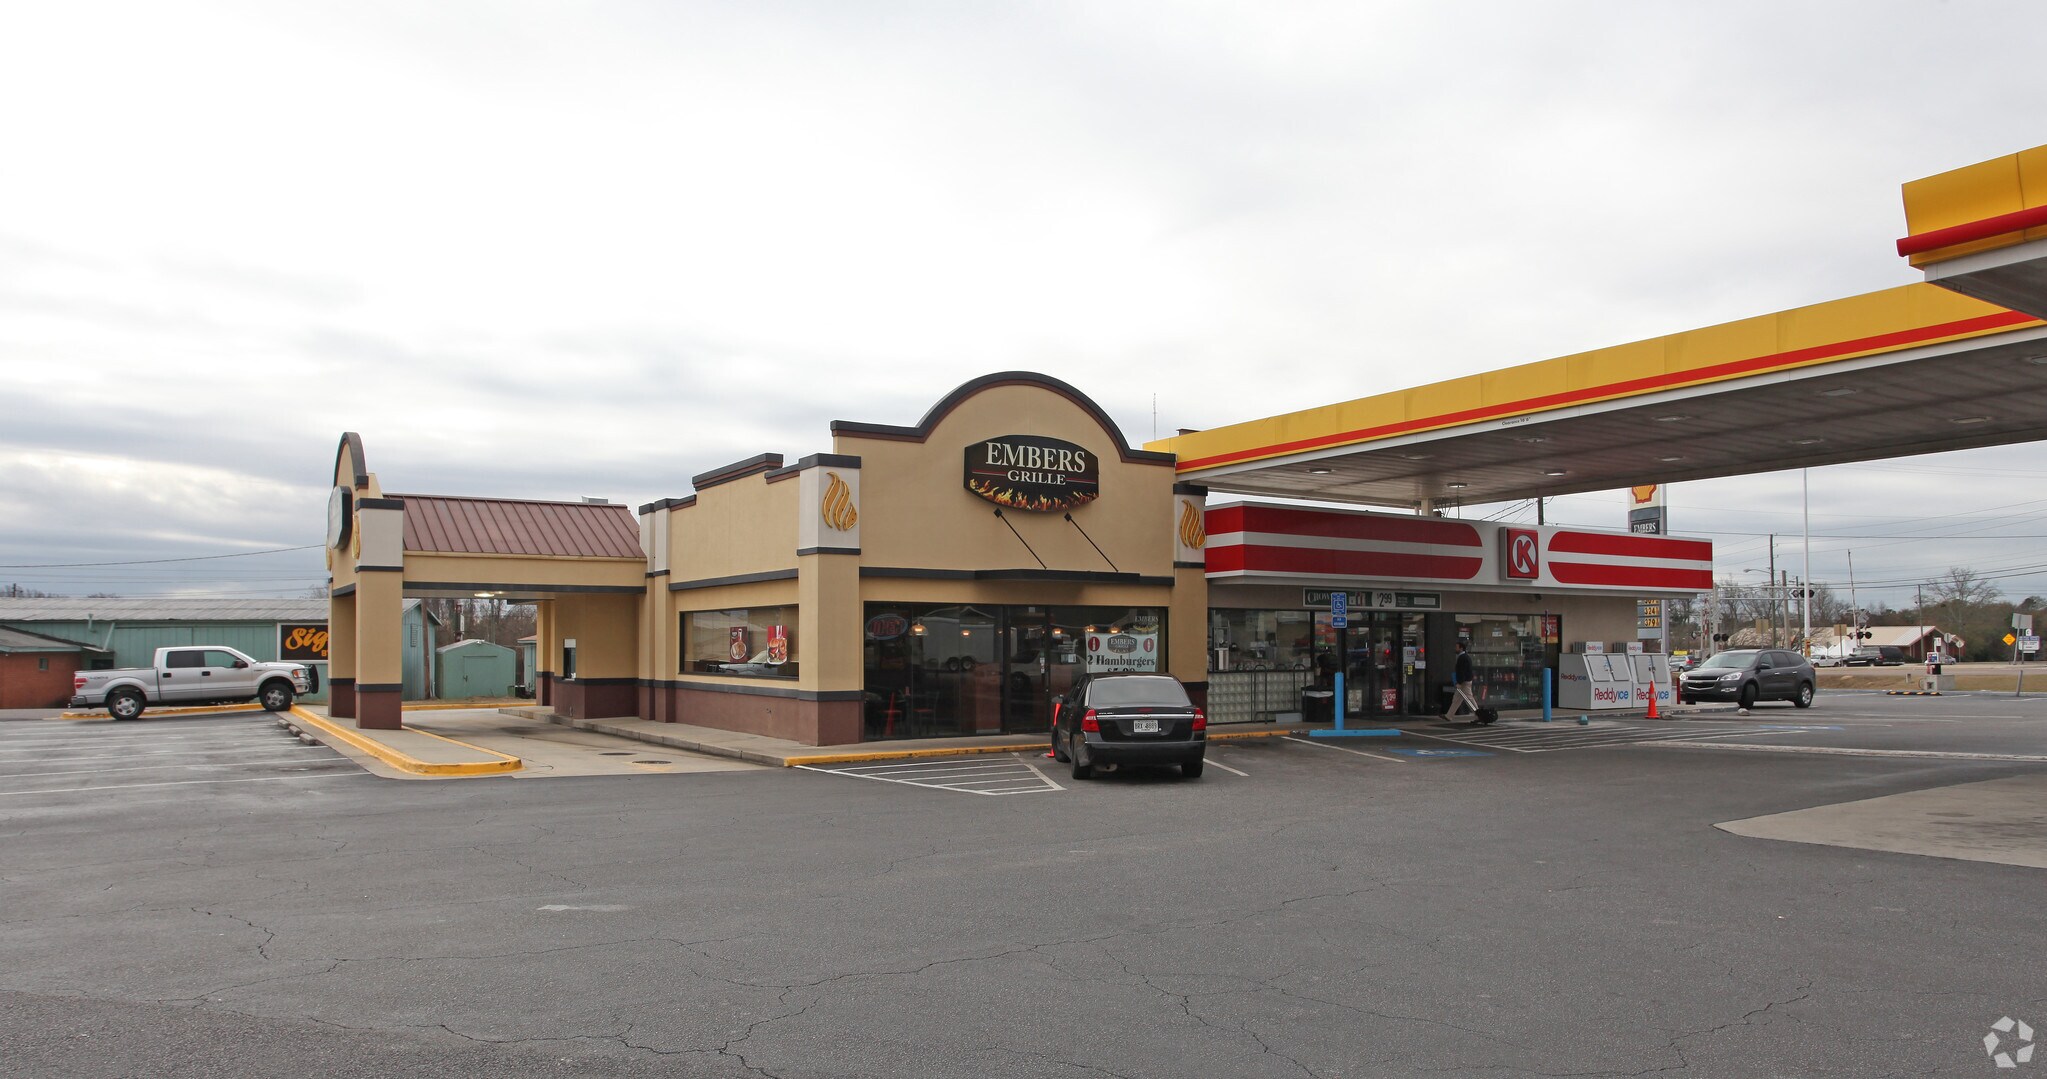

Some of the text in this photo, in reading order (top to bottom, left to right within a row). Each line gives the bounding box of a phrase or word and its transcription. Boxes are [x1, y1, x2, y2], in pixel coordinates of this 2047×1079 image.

[985, 442, 1087, 473] EMBERS
[1007, 470, 1067, 486] GRILLE
[1516, 539, 1536, 572] K
[1307, 592, 1331, 604] CROW
[1087, 655, 1155, 668] 2 Hamburgers
